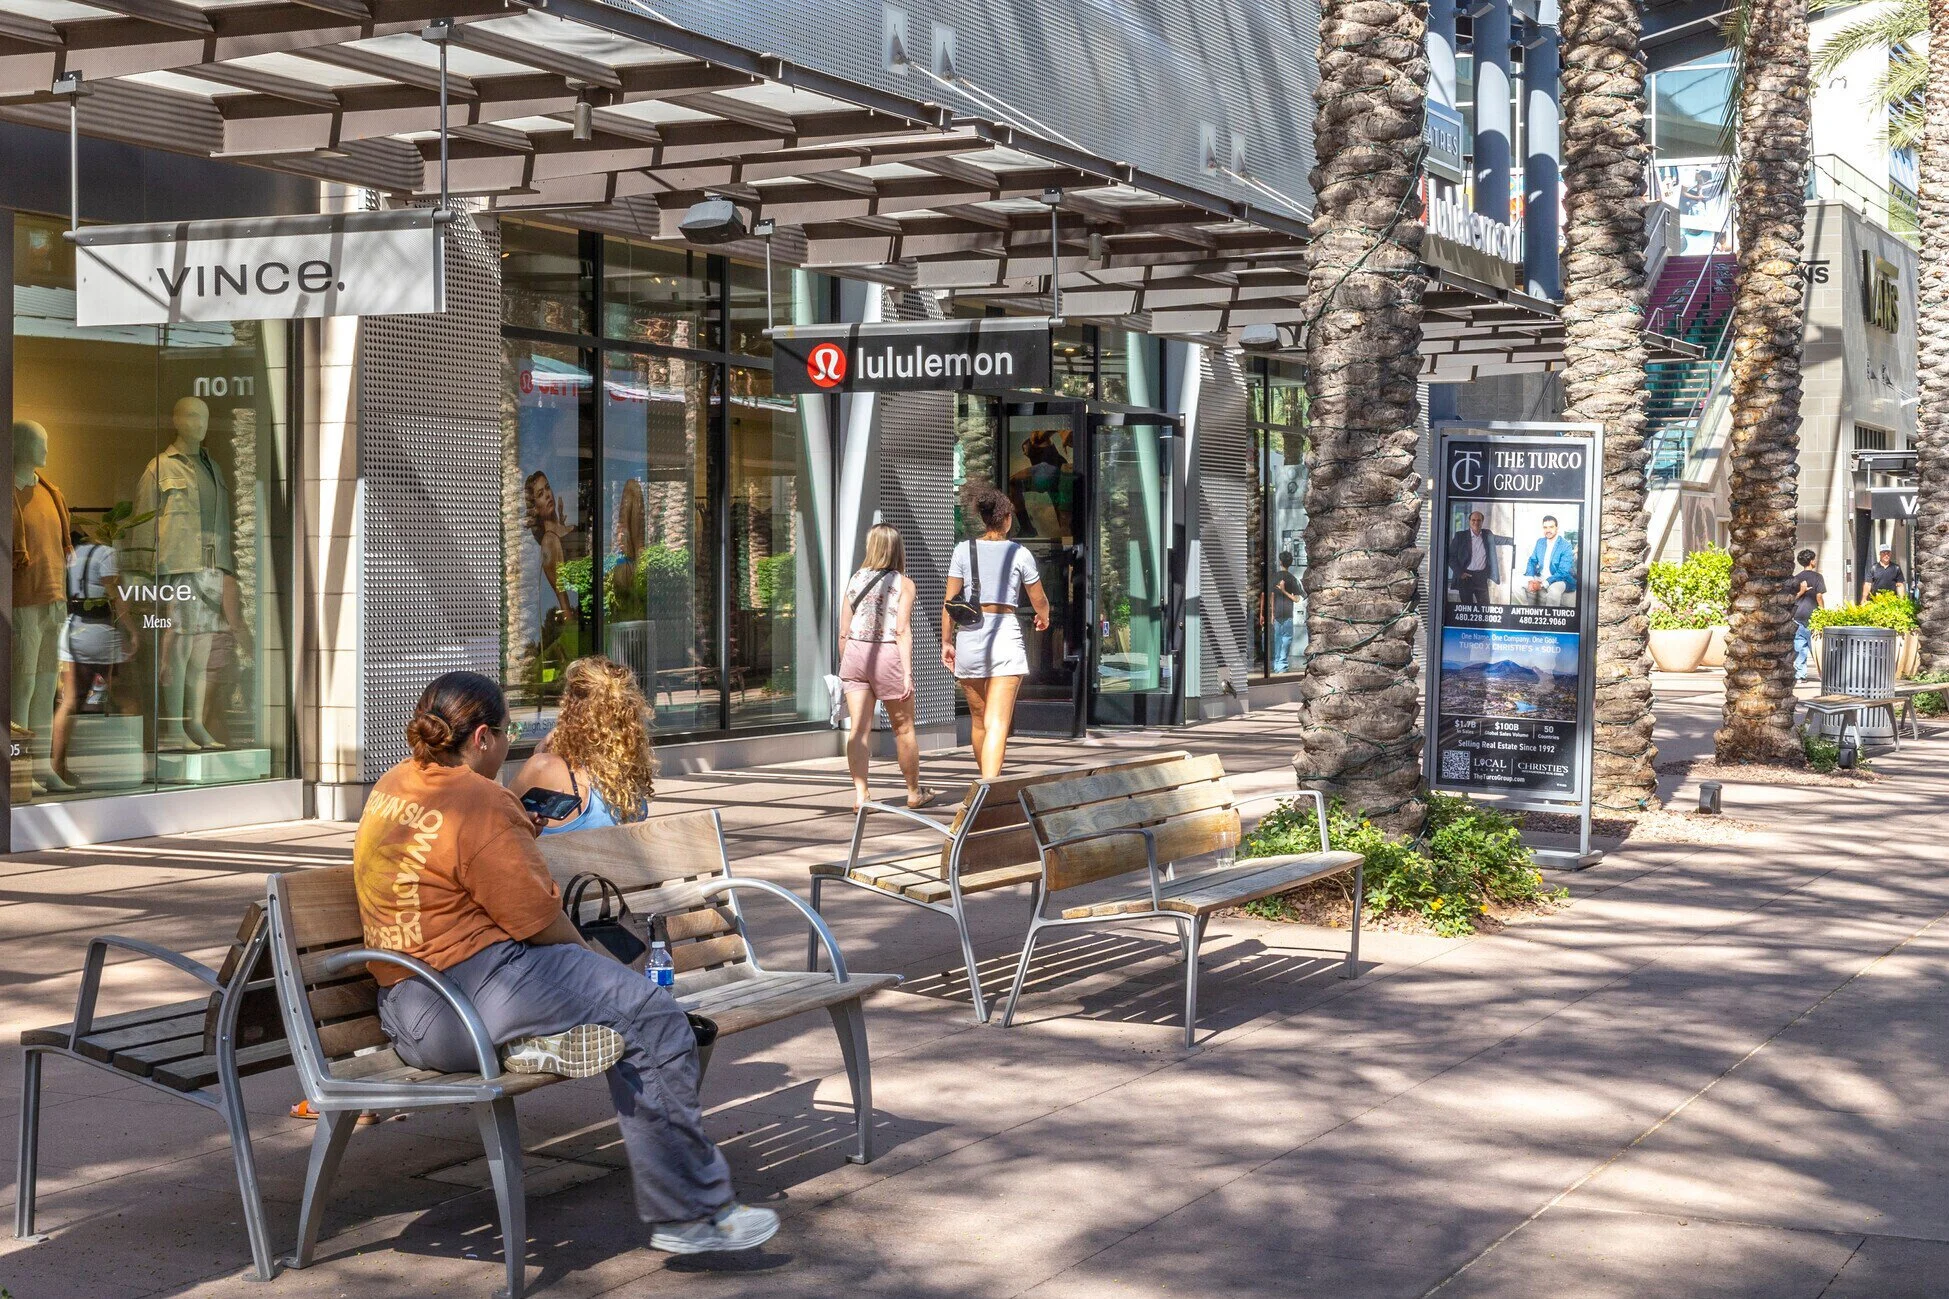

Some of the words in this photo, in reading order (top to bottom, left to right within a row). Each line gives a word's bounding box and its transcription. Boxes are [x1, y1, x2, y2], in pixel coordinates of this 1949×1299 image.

[857, 345, 1013, 379] lululemon
[1495, 451, 1525, 468] THE
[1528, 452, 1582, 469] TURCO
[1493, 474, 1543, 492] GROUP
[1454, 604, 1472, 612] JOHN
[1473, 605, 1480, 613] A.
[1481, 605, 1504, 614] TURCO
[1511, 607, 1544, 616] ANTHONY
[1552, 609, 1575, 617] TURCO
[142, 614, 172, 629] Mens
[1455, 613, 1502, 623] 480.228.8002
[1519, 616, 1567, 626] 480.232.9060
[1461, 632, 1473, 640] One
[1492, 633, 1503, 642] One
[1531, 636, 1543, 644] One
[1492, 643, 1533, 652] CHRISTIE'S
[1541, 645, 1562, 654] SOLD
[1494, 721, 1519, 731] $100B
[1544, 725, 1554, 734] 50
[1458, 739, 1481, 750] Selling
[1481, 741, 1496, 749] Real
[1497, 741, 1518, 750] Estate
[1519, 743, 1537, 752] Since
[1539, 744, 1555, 754] 1992
[1517, 762, 1569, 774] CHRISTIE'S
[400, 802, 444, 865] SLOW
